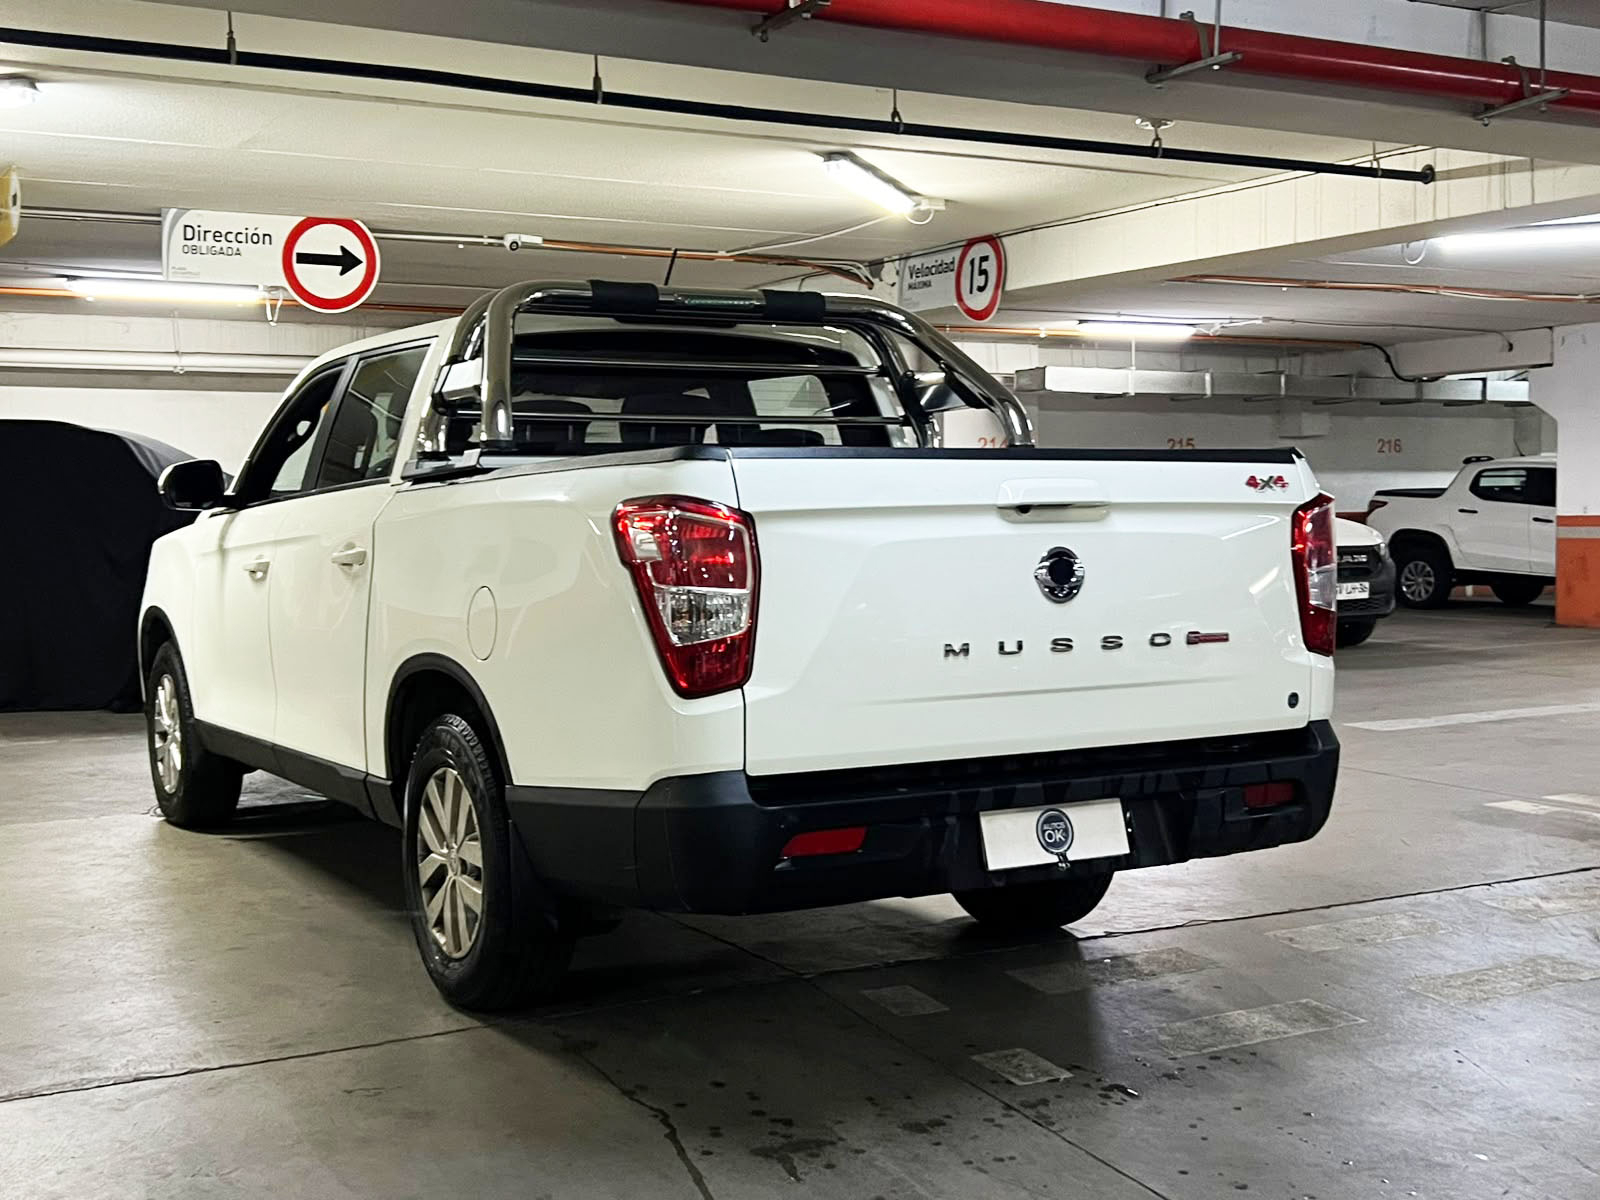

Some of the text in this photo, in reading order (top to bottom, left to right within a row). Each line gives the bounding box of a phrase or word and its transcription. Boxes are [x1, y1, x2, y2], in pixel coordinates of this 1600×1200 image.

[183, 225, 272, 245] Dirección
[182, 245, 242, 256] OBLIGADA
[908, 256, 955, 279] Velocidad
[969, 255, 989, 294] 15
[1167, 437, 1195, 449] 215
[1377, 438, 1402, 453] 216
[944, 631, 1172, 658] MUSSO
[1044, 829, 1067, 843] OK
